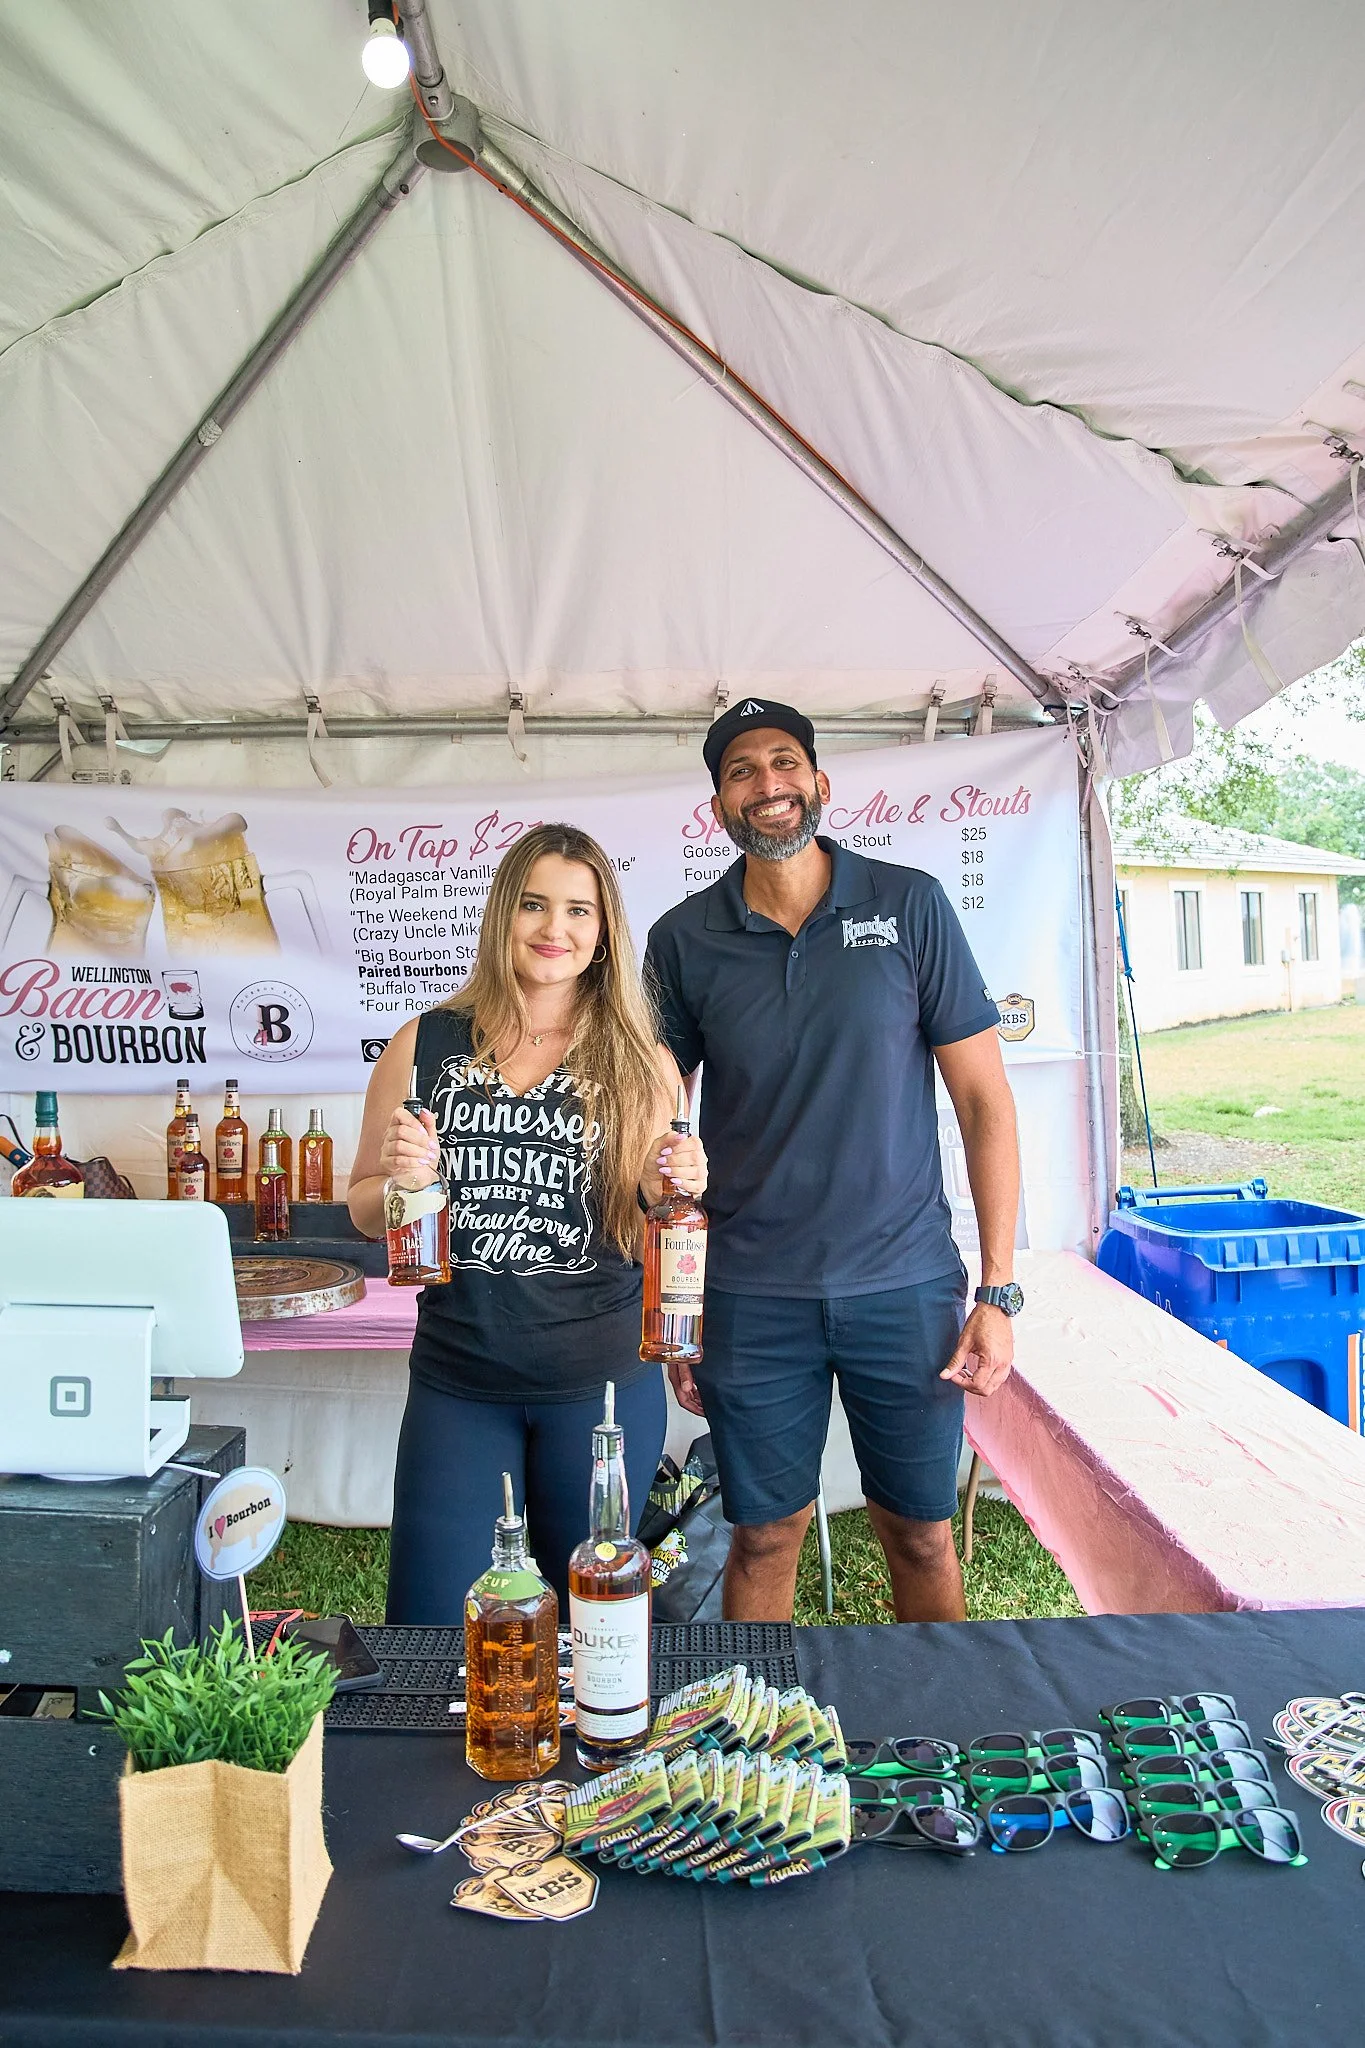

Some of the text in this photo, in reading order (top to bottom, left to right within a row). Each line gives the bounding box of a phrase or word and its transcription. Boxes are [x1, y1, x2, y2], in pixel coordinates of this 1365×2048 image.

[828, 784, 1032, 830] Ale & Stouts
[347, 827, 396, 864] On
[399, 824, 458, 868] Tap
[683, 844, 730, 859] Goose
[852, 833, 892, 848] Stout
[961, 826, 987, 842] $25
[961, 850, 984, 865] $18
[349, 869, 445, 887] "Madagascar
[961, 873, 984, 888] $18
[350, 881, 492, 904] (Royal Palm Brewin
[961, 896, 985, 910] $12
[350, 909, 384, 924] "The
[388, 905, 457, 923] Weekend
[353, 926, 399, 943] (Crazy
[404, 923, 446, 939] Uncle
[355, 948, 385, 965] "Big
[388, 946, 451, 962] Bourbon
[71, 965, 152, 985] WELLINGTON
[358, 963, 468, 979] Paired Bourbons
[0, 958, 166, 1021] Bacon
[419, 980, 459, 993] Trace
[1002, 1013, 1027, 1025] KBS
[15, 1022, 207, 1064] & BOURBON
[442, 1145, 586, 1194] WHISKEY
[460, 1184, 566, 1210] SWEET AS
[449, 1199, 582, 1248] Strawberry
[471, 1232, 556, 1264] Wine
[208, 1497, 272, 1539] I Bourbon
[574, 1626, 634, 1649] DUKE
[518, 1870, 582, 1903] KBS
